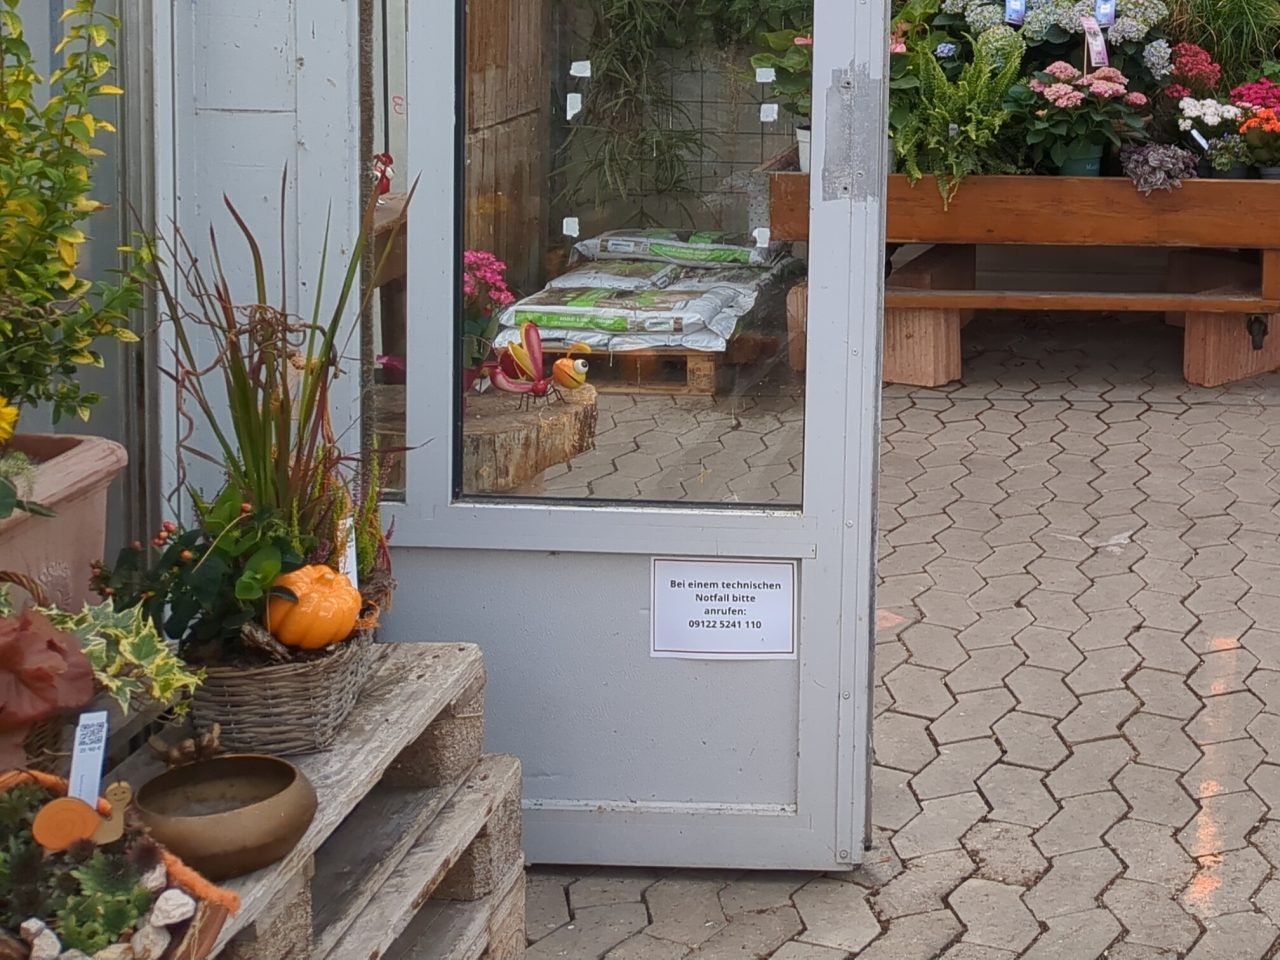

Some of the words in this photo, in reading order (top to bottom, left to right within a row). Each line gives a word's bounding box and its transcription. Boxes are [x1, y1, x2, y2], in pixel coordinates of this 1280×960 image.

[670, 580, 685, 588] Bei
[688, 581, 719, 589] einem
[721, 581, 782, 590] technischen
[695, 594, 730, 602] Notfall
[732, 594, 756, 603] bitte
[704, 607, 747, 616] anrufen:
[688, 620, 717, 629] 09122
[719, 620, 741, 629] 5241
[746, 620, 762, 629] 110
